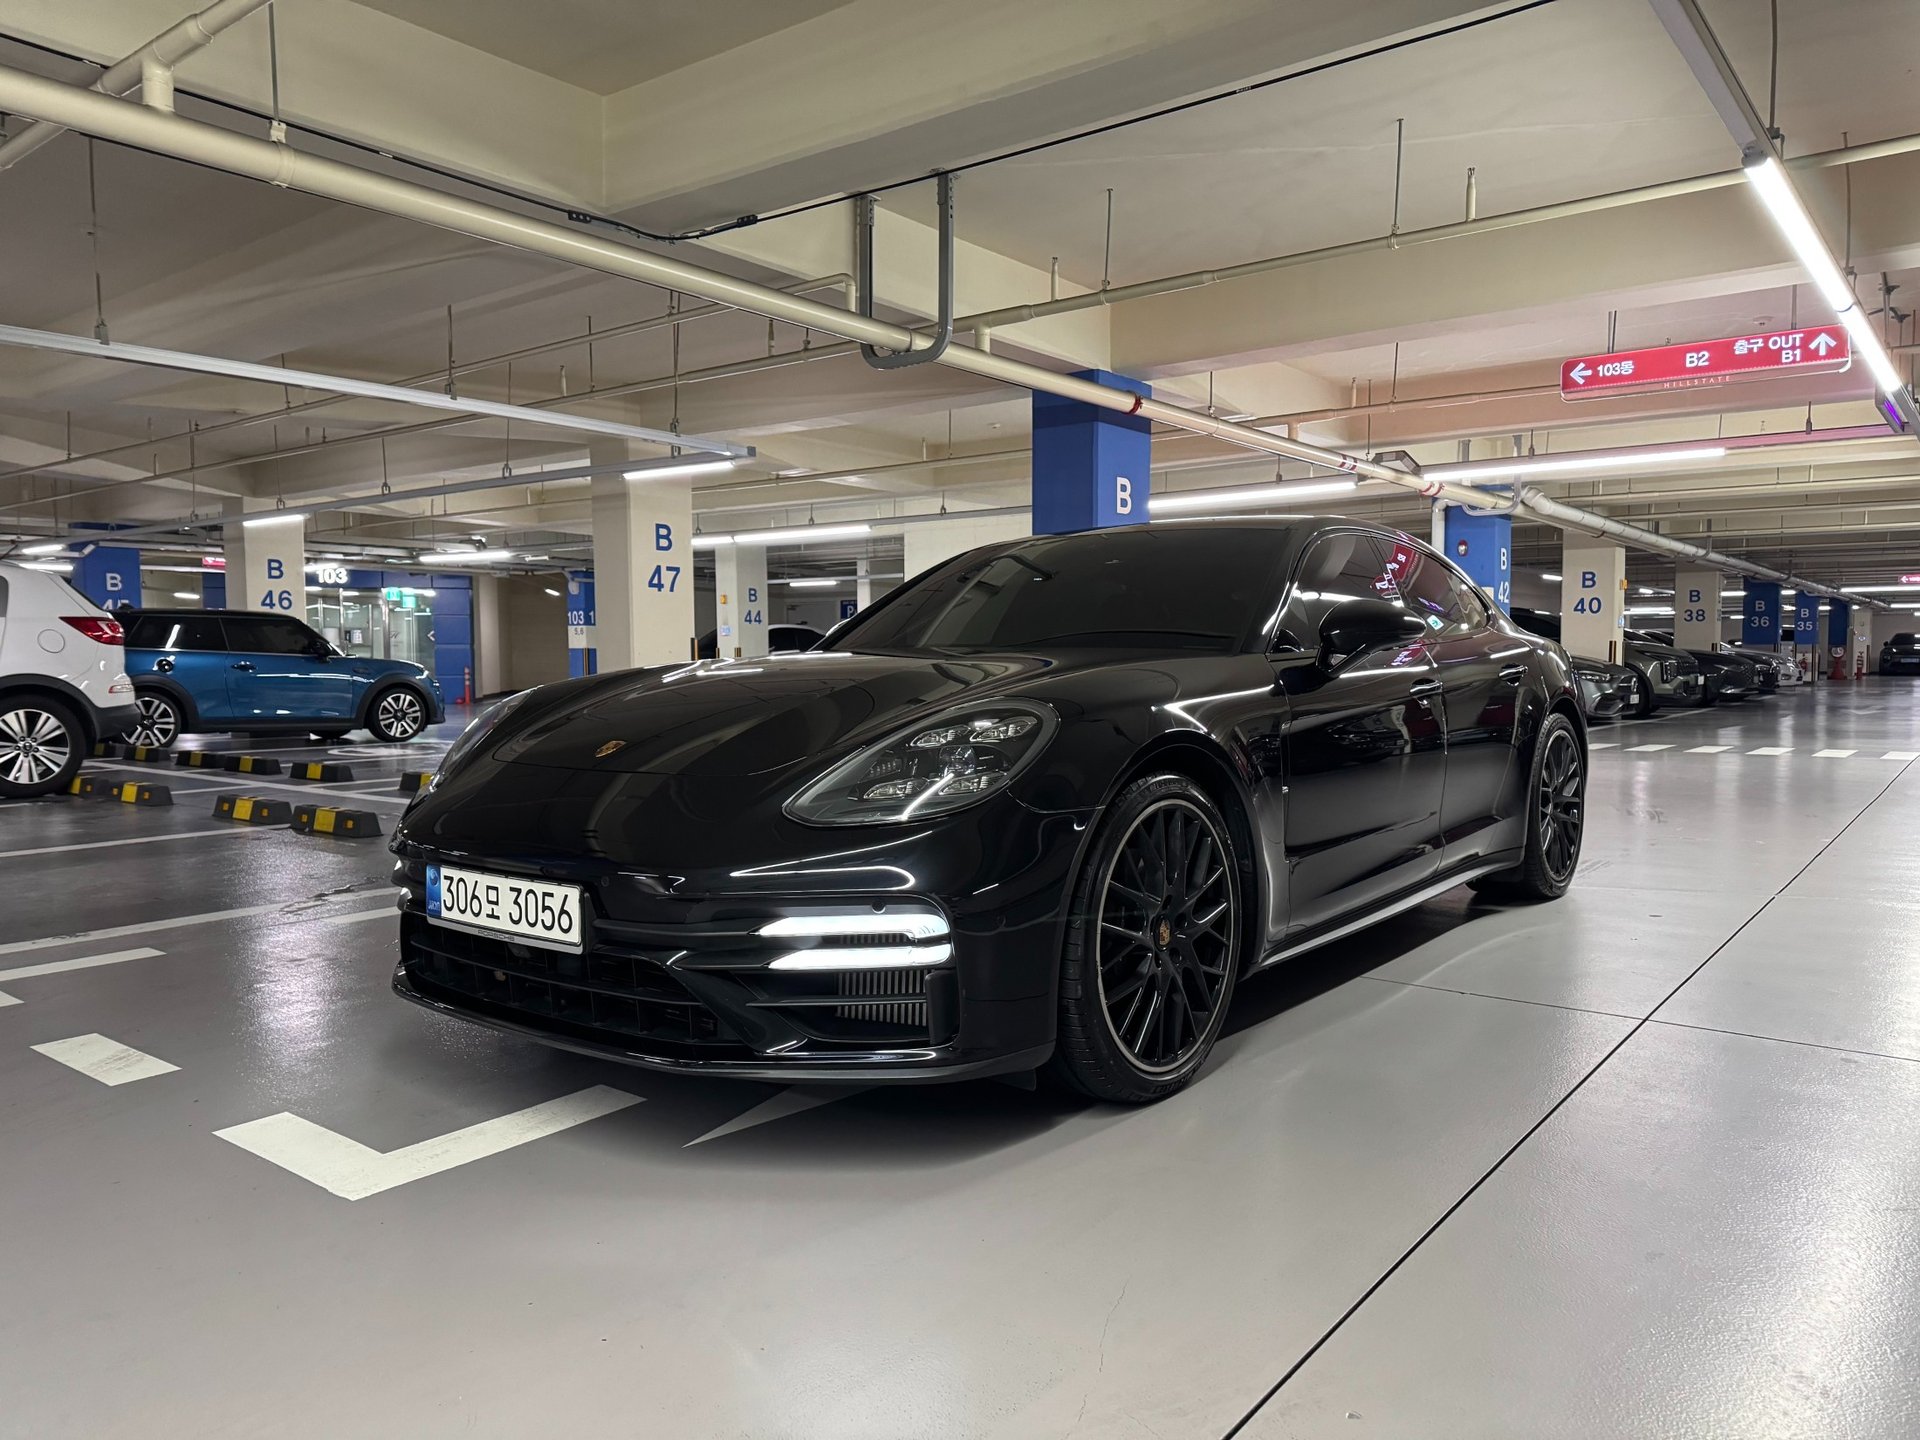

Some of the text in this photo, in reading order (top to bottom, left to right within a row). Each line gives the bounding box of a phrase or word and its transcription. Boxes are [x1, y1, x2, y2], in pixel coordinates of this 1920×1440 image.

[1734, 333, 1804, 355] 출구 OUT
[1685, 351, 1710, 368] B2
[1781, 349, 1801, 363] B1
[1597, 360, 1634, 377] 103동
[1663, 375, 1731, 389] HILLSTATE
[1116, 476, 1132, 515] B
[655, 523, 673, 551] B
[1500, 548, 1508, 570] B
[267, 559, 284, 579] B
[316, 568, 348, 583] 103
[105, 572, 122, 591] B
[647, 565, 681, 592] 47
[1582, 571, 1597, 589] B
[260, 590, 293, 610] 46
[748, 588, 758, 603] B
[1498, 581, 1510, 603] 42
[1689, 590, 1701, 603] B
[1573, 597, 1602, 614] 40
[1755, 600, 1765, 612] B
[1800, 608, 1810, 618] B
[567, 611, 584, 625] 103
[744, 610, 762, 625] 44
[1683, 609, 1706, 622] 38
[1751, 616, 1770, 628] 36
[1797, 621, 1813, 631] 35
[443, 875, 573, 934] 306모 3056
